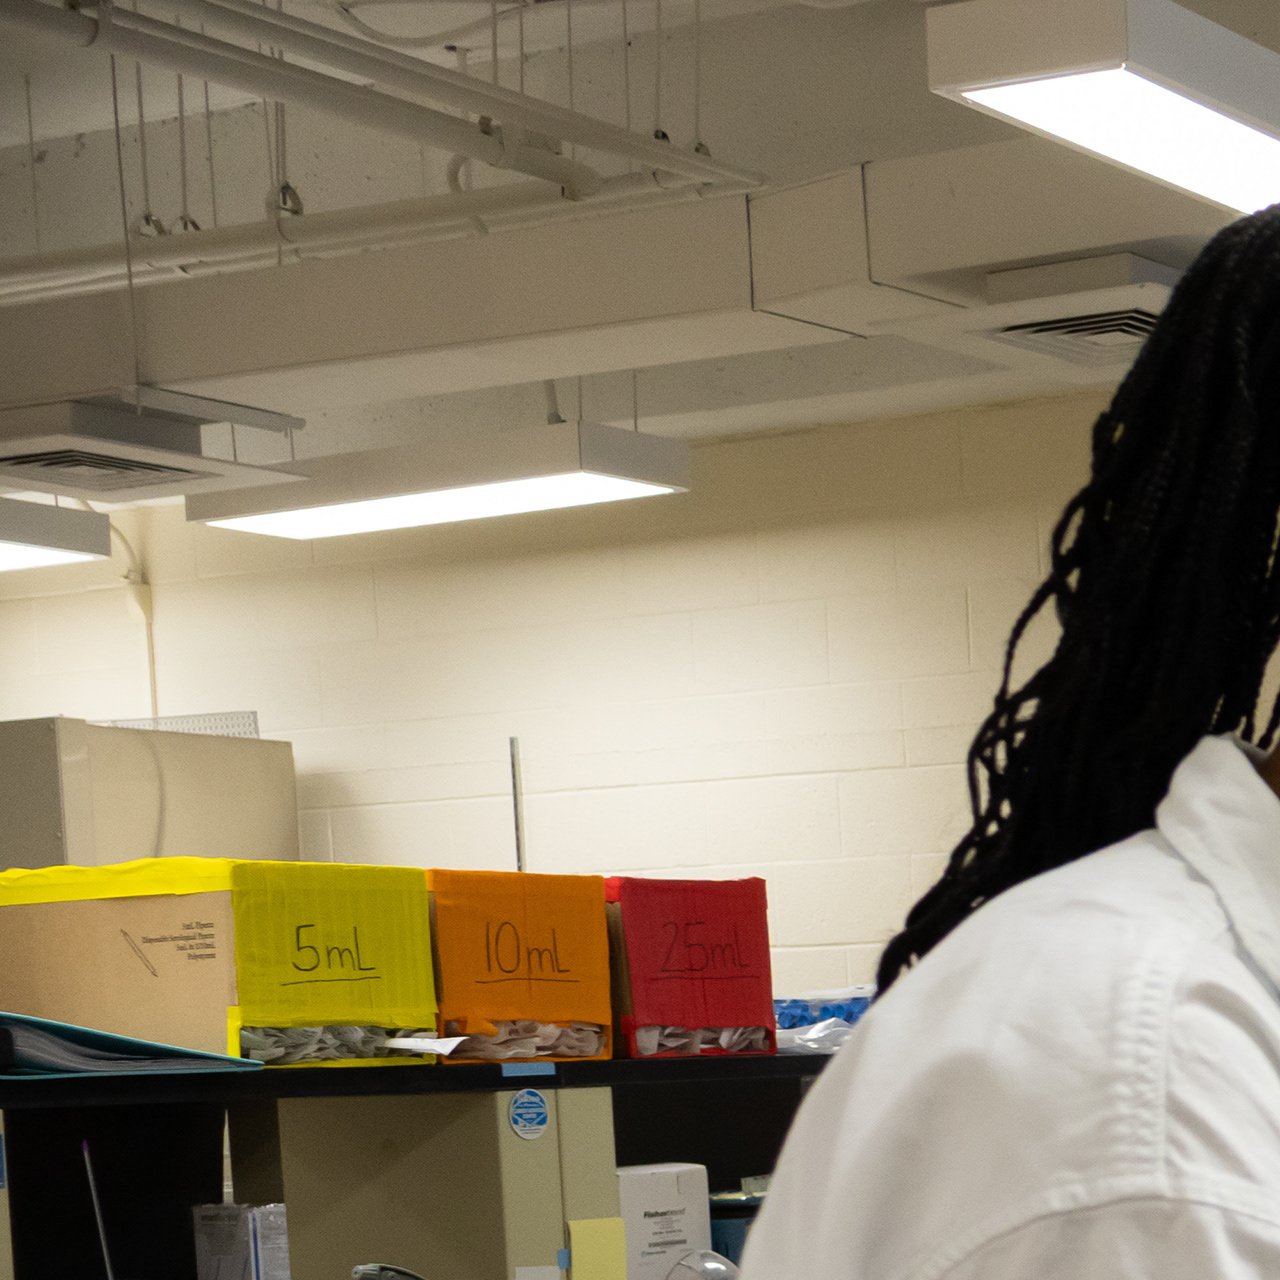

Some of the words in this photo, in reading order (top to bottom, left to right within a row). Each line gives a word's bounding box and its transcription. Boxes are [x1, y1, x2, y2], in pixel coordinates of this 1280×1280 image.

[292, 924, 376, 972] 5mL
[485, 921, 570, 975] 10mL
[660, 921, 750, 974] 25mL
